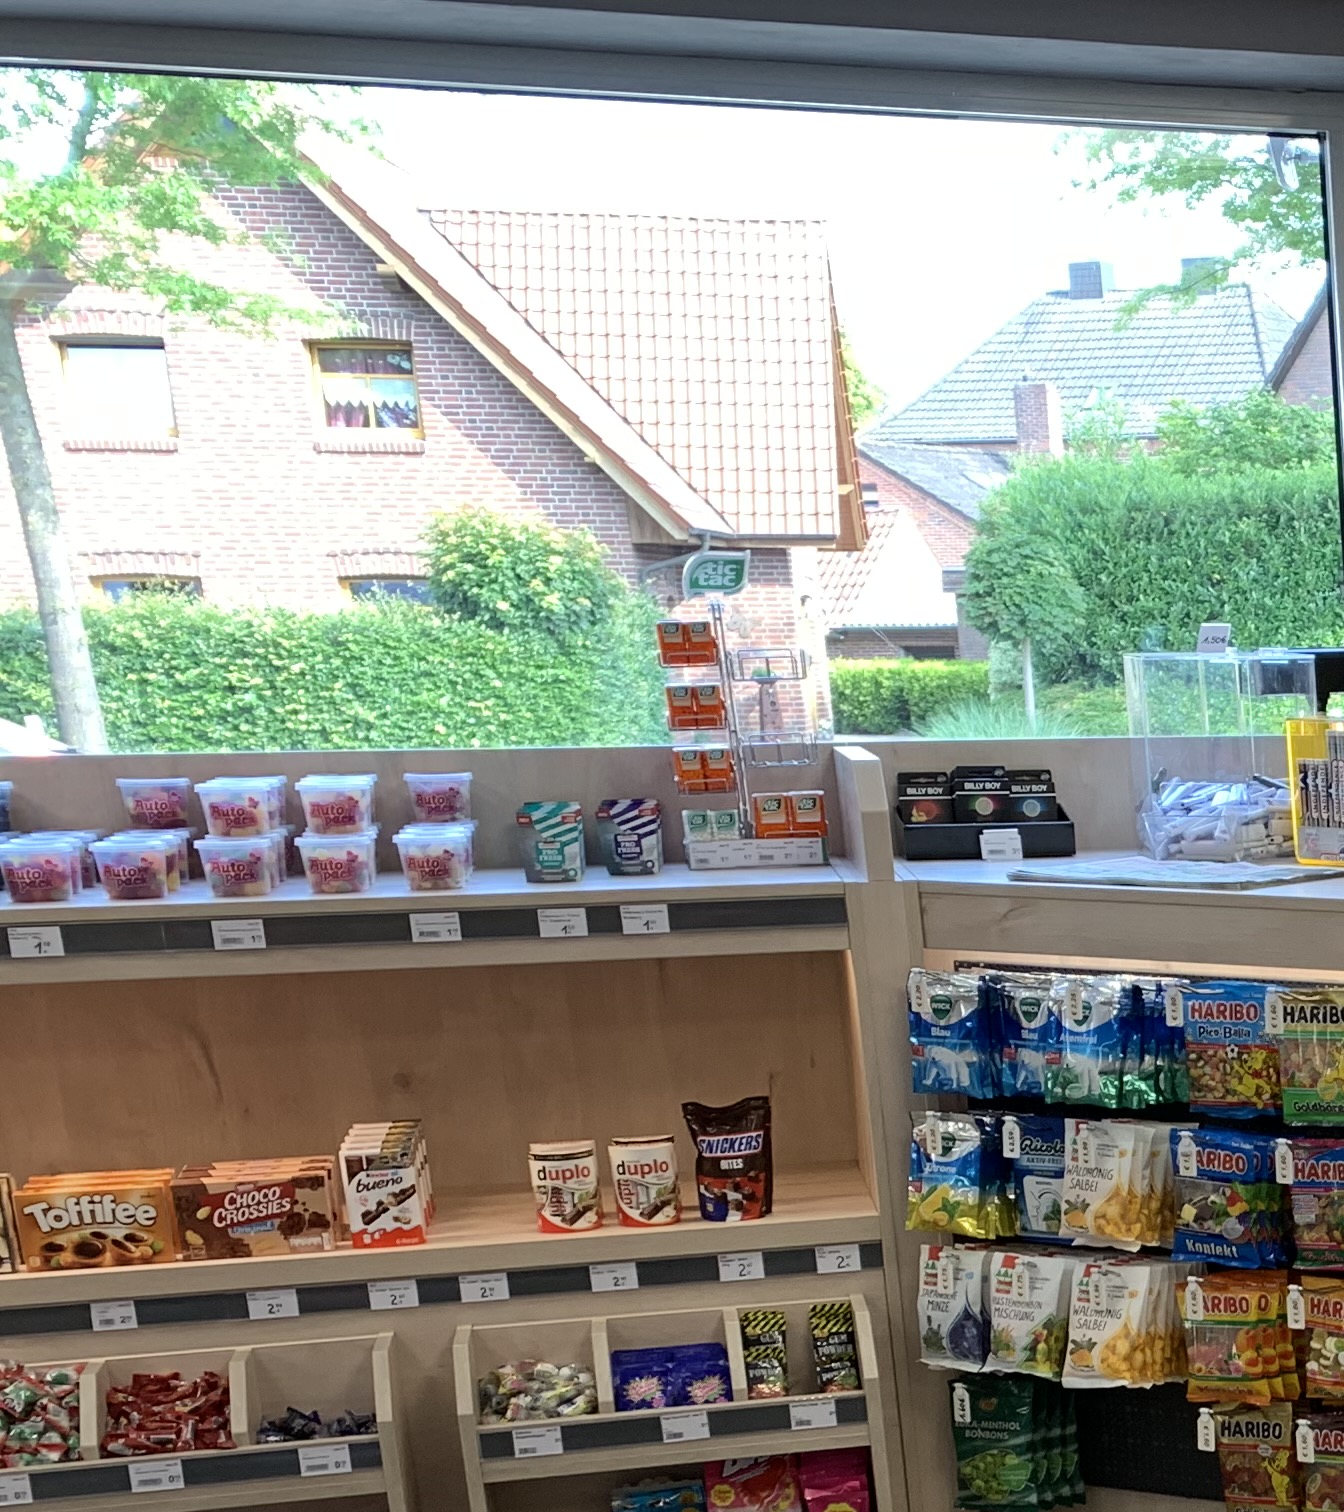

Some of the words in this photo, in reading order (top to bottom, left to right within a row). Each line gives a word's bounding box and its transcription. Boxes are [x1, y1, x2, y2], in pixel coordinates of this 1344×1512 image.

[707, 561, 738, 575] tic
[698, 573, 736, 587] tac
[964, 782, 983, 790] BILLY
[985, 782, 1001, 791] BOY
[133, 800, 169, 814] Auto
[143, 810, 180, 824] pack
[931, 1002, 952, 1010] WICK
[1190, 1002, 1259, 1022] HARIBO
[930, 1026, 951, 1037] Blau
[1198, 1024, 1251, 1039] Pico-Balla
[699, 1133, 762, 1156] SNICKERS
[616, 1159, 669, 1179] duplo
[720, 1158, 743, 1170] BITES
[537, 1164, 591, 1188] duplo
[355, 1174, 403, 1194] bueno
[1070, 1178, 1098, 1191] SALBEI
[224, 1186, 280, 1208] CHOCO
[24, 1195, 157, 1233] Toffifee
[212, 1199, 291, 1228] CROSSIES
[1185, 1239, 1238, 1258] Konfekt
[926, 1300, 950, 1312] MINZE
[993, 1307, 1035, 1322] MISCHUNG
[1075, 1319, 1108, 1331] SALBEI
[965, 1430, 1009, 1440] BONBONS
[1221, 1421, 1283, 1440] HARIBO
